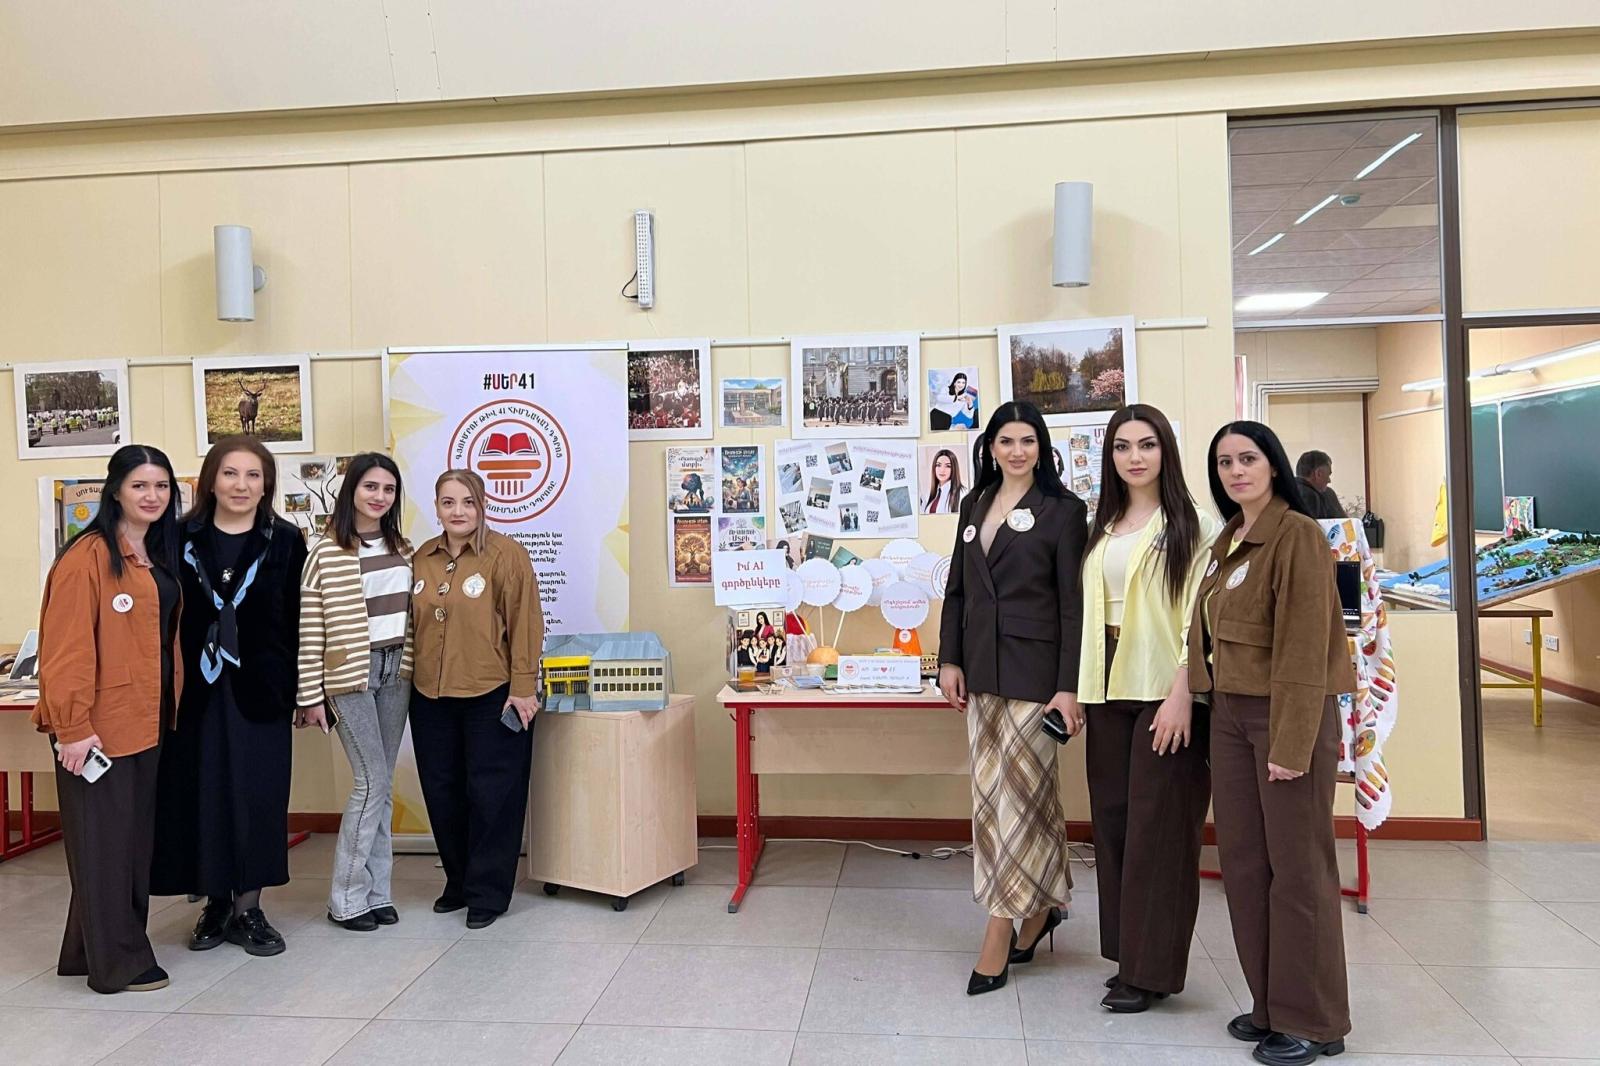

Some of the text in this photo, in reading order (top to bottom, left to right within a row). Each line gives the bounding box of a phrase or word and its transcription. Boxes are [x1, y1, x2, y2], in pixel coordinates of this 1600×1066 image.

[456, 419, 478, 460] ԳՅՈՒՄՐՈՒ
[507, 406, 550, 431] ՀԻՄՆԱԿԱՆ
[549, 429, 563, 458] ԴՊՐՈՑ
[752, 561, 764, 570] AI
